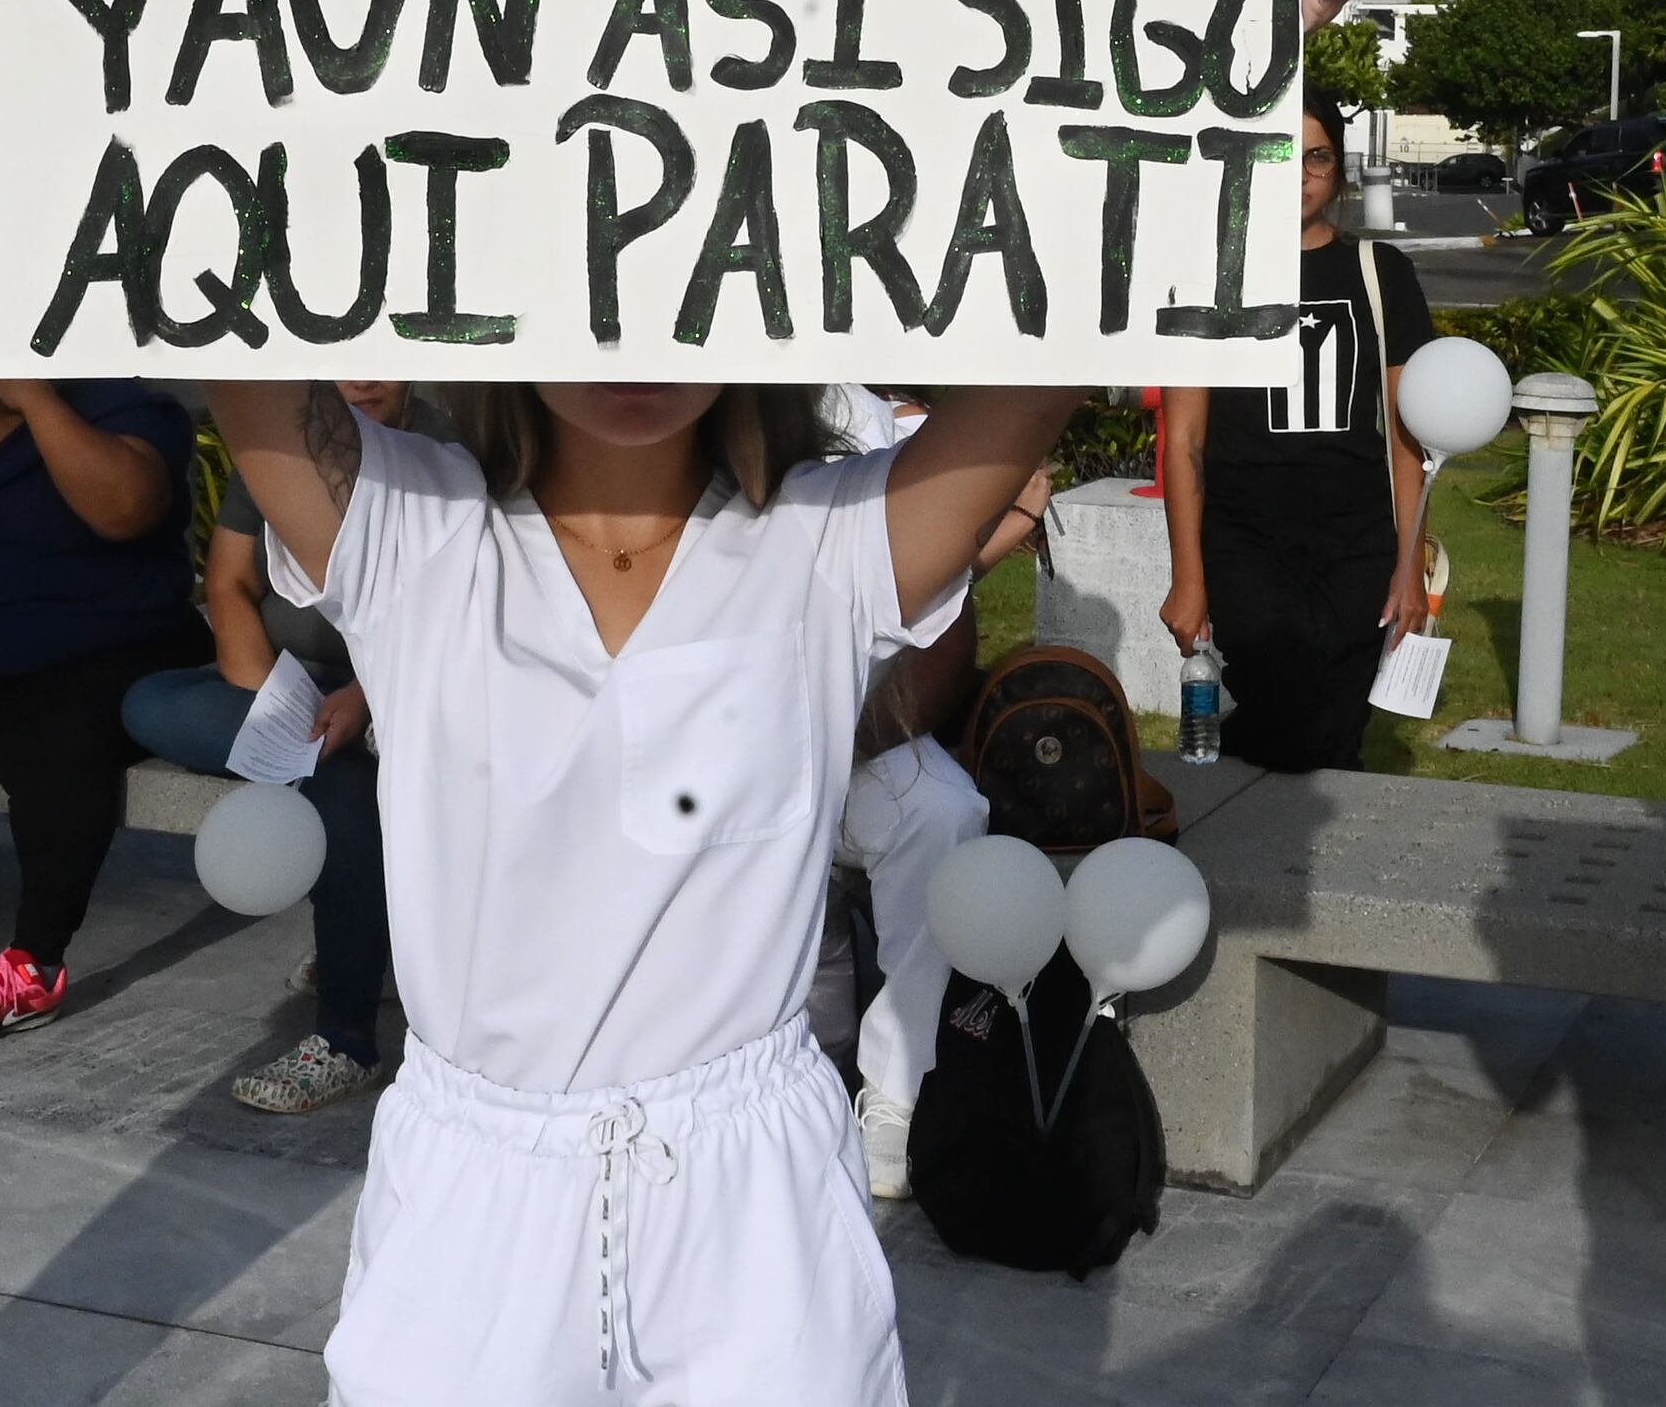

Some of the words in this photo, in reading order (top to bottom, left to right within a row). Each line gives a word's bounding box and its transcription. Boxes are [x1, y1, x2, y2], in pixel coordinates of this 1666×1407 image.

[30, 128, 519, 358] AQUI
[554, 96, 1046, 348] PARA
[1057, 124, 1300, 340] TI
